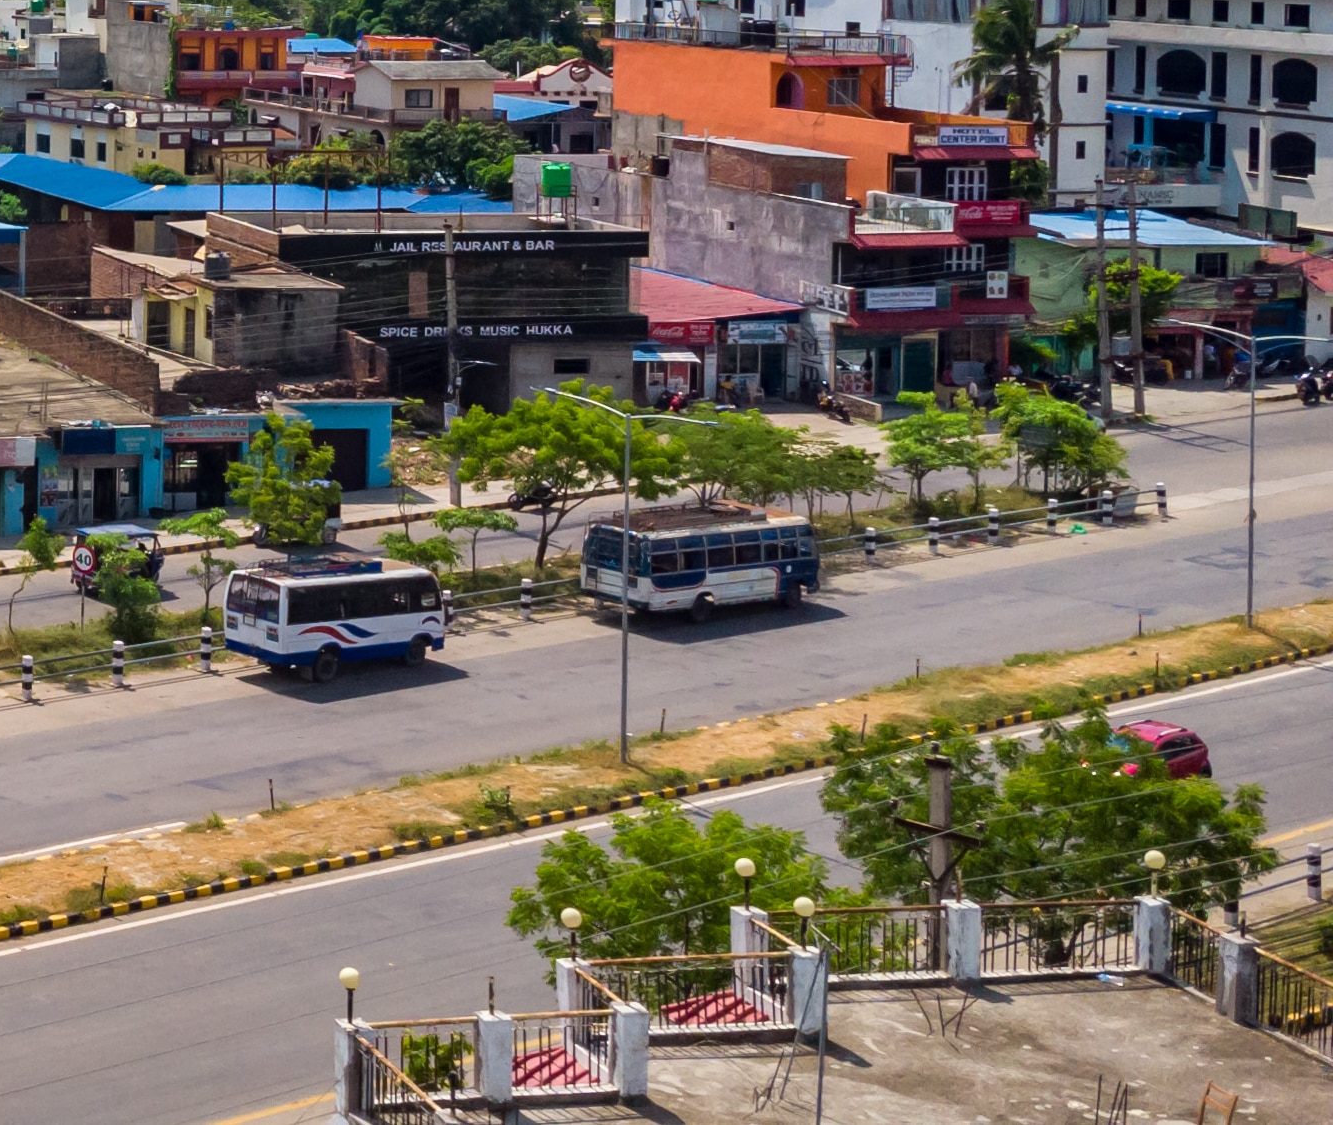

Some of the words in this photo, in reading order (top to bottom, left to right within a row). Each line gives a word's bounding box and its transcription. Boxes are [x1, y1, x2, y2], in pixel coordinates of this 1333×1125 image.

[941, 135, 977, 143] CENTER
[979, 135, 1006, 143] POINT
[390, 242, 418, 252] JAIL
[512, 241, 522, 251] &
[525, 240, 555, 250] BAR
[380, 327, 418, 337] SPICE
[424, 326, 473, 337] DRIKS
[479, 326, 519, 336] MUSIC
[526, 325, 573, 335] HUKKA
[76, 553, 92, 566] 40
